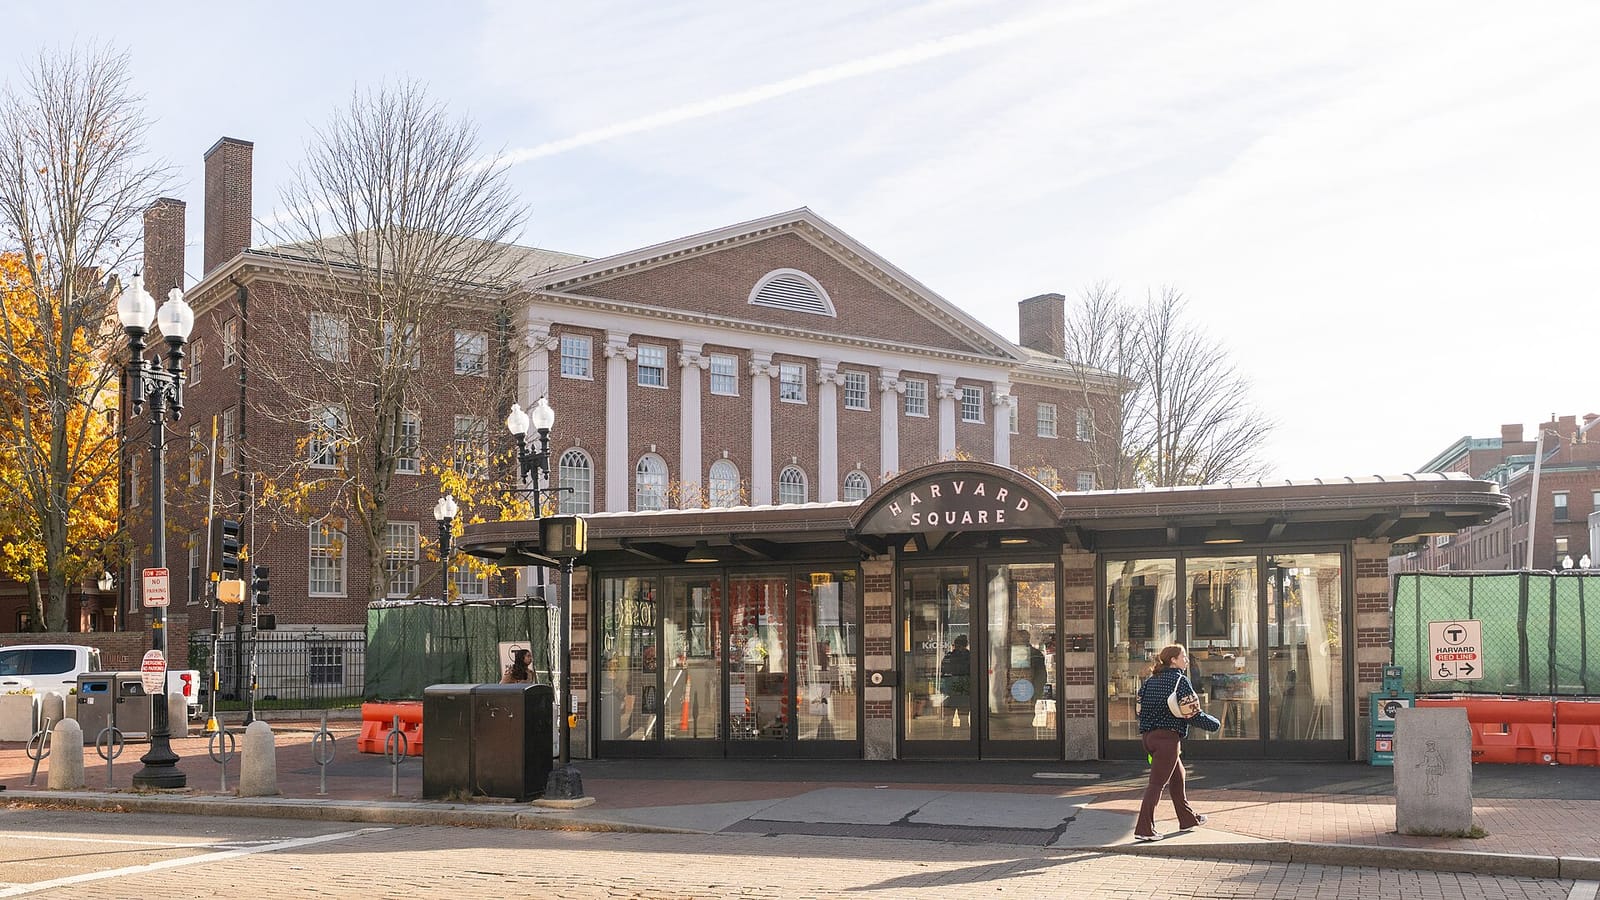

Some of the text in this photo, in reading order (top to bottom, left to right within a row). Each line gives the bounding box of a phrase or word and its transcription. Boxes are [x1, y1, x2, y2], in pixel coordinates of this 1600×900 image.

[889, 481, 1029, 516] HARVARD
[910, 509, 1005, 527] SQUARE
[1447, 629, 1462, 641] T
